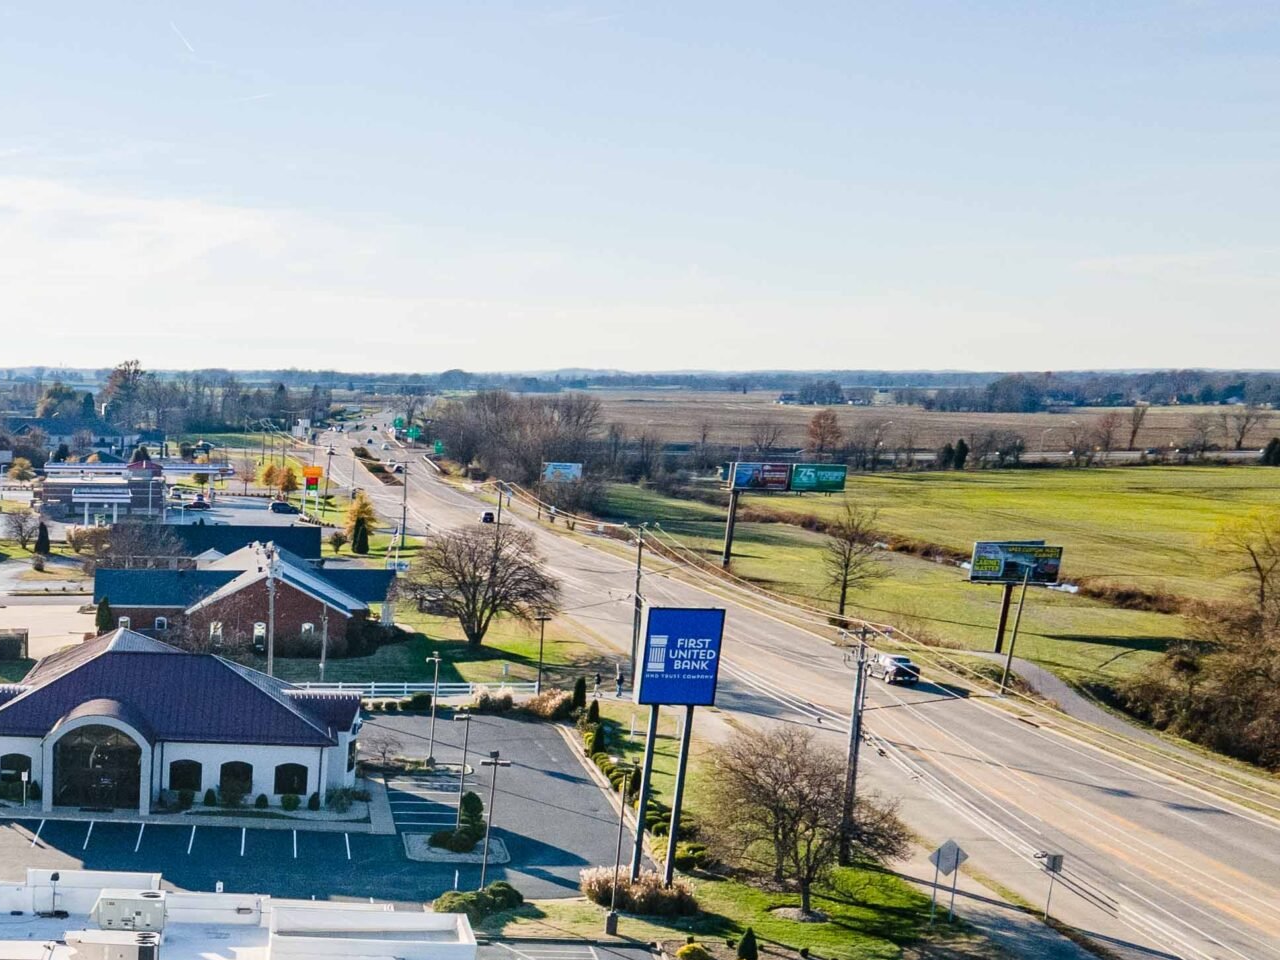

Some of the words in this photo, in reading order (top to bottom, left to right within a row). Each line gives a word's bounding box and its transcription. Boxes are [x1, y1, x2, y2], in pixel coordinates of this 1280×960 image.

[677, 638, 712, 649] FIRST
[669, 649, 716, 660] UNITED
[673, 660, 709, 670] BANK
